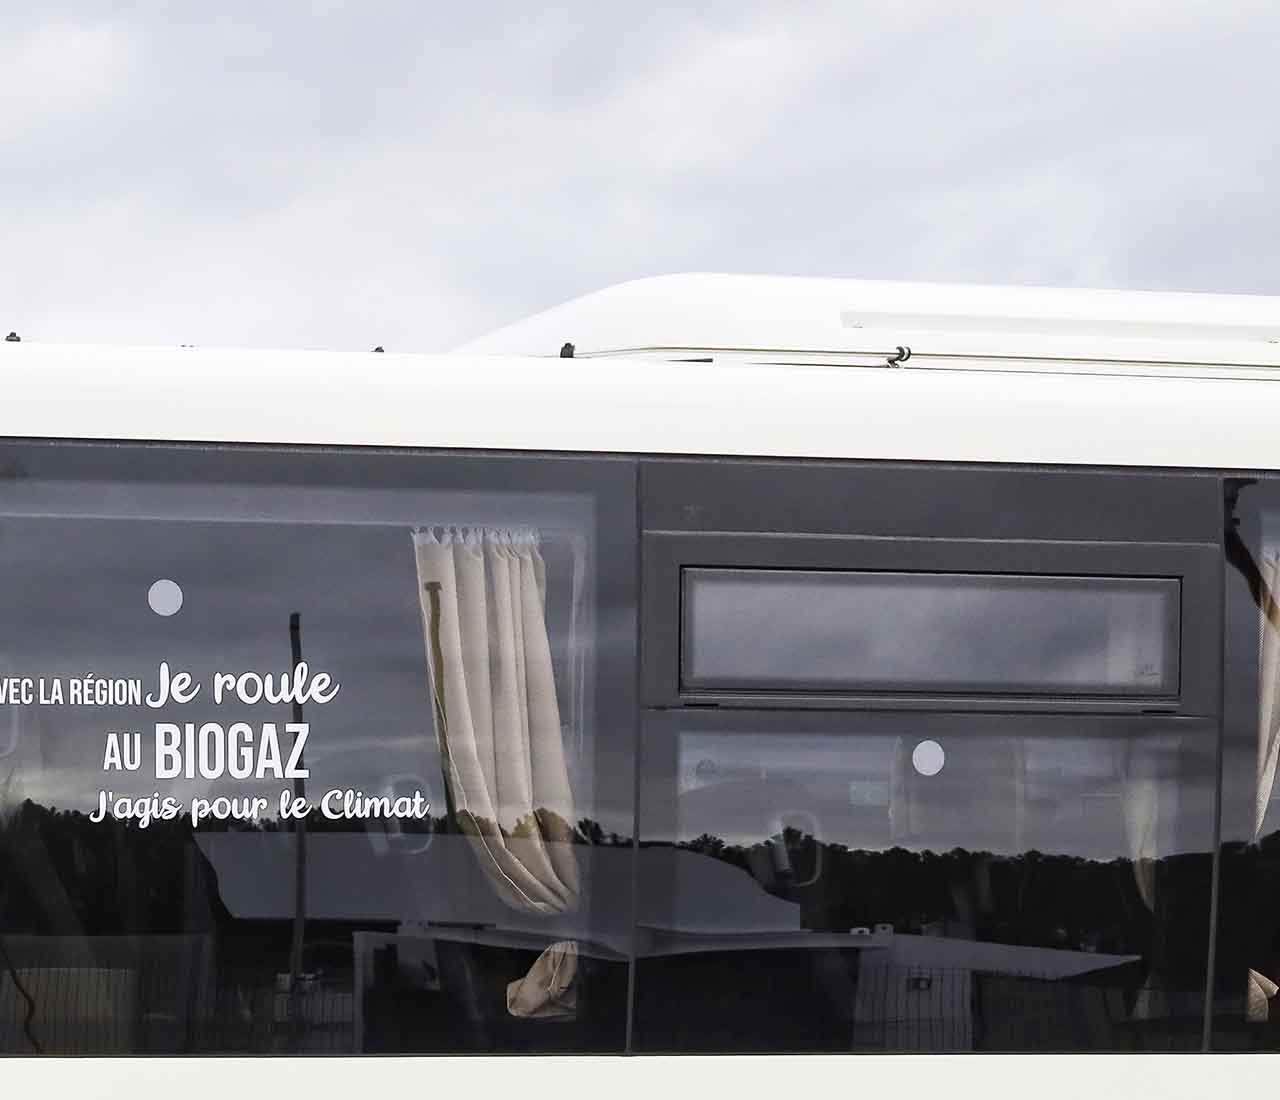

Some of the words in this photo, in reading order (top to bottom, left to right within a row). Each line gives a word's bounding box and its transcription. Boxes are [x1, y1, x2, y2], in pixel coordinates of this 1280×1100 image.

[39, 678, 64, 705] LA
[69, 673, 142, 706] RÉGION
[145, 662, 201, 707] Je
[214, 661, 340, 705] roule
[103, 733, 142, 771] AU
[155, 722, 310, 780] BIOGAZ
[89, 790, 183, 829] J'agis
[191, 797, 268, 828] pour
[279, 789, 313, 819] le
[321, 789, 430, 820] Climat
